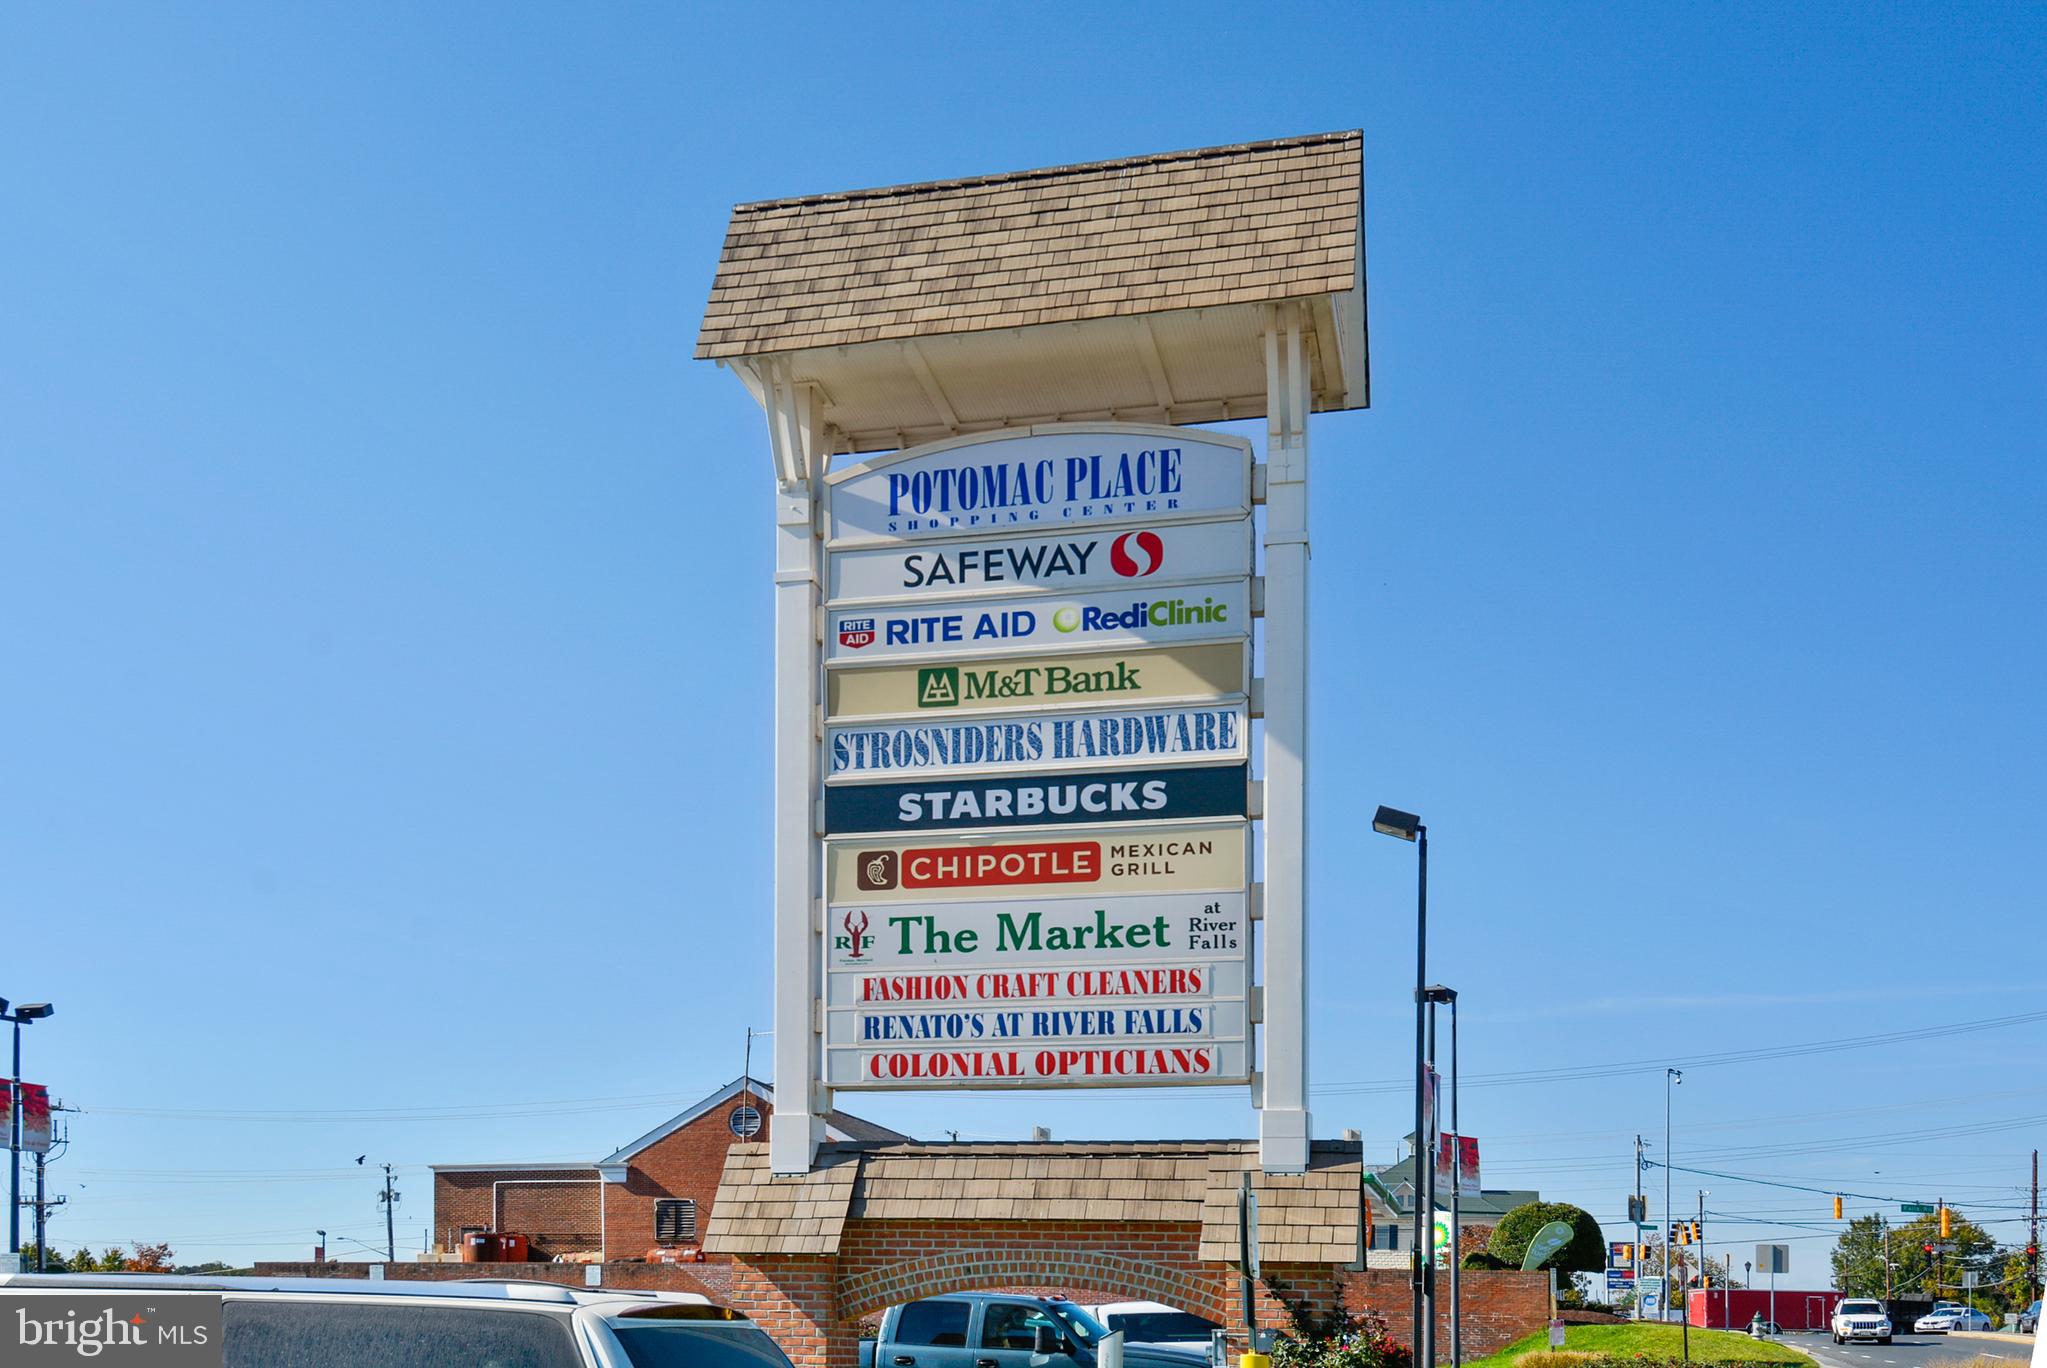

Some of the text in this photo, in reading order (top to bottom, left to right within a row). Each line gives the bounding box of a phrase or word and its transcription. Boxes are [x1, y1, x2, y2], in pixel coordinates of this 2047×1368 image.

[888, 448, 1182, 517] POTOMAC PLACE
[888, 498, 1180, 533] SHOPPING CENTER
[903, 541, 1098, 588] SAFEWAY
[844, 619, 871, 631] RITE
[886, 610, 1036, 646] RITE AID
[1082, 597, 1228, 632] RediClinic
[846, 633, 869, 645] AID
[964, 661, 1141, 700] M&T Bank
[833, 710, 1238, 772] STROSNIDERS HARDWARE
[898, 780, 1168, 822] STARBUCKS
[910, 850, 1092, 881] CHIPOTLE
[1111, 841, 1213, 858] MEXICAN
[1111, 860, 1176, 876] GRILL
[1204, 901, 1221, 914] at
[888, 910, 1171, 955] The Market
[1189, 917, 1237, 933] River
[1189, 934, 1238, 950] Falls
[863, 968, 1202, 1001] FASHION CRAFT CLEANERS
[864, 1008, 1202, 1040] RENATO'S AT RIVER FALLS
[870, 1048, 1211, 1079] COLONIAL OPTICIANS
